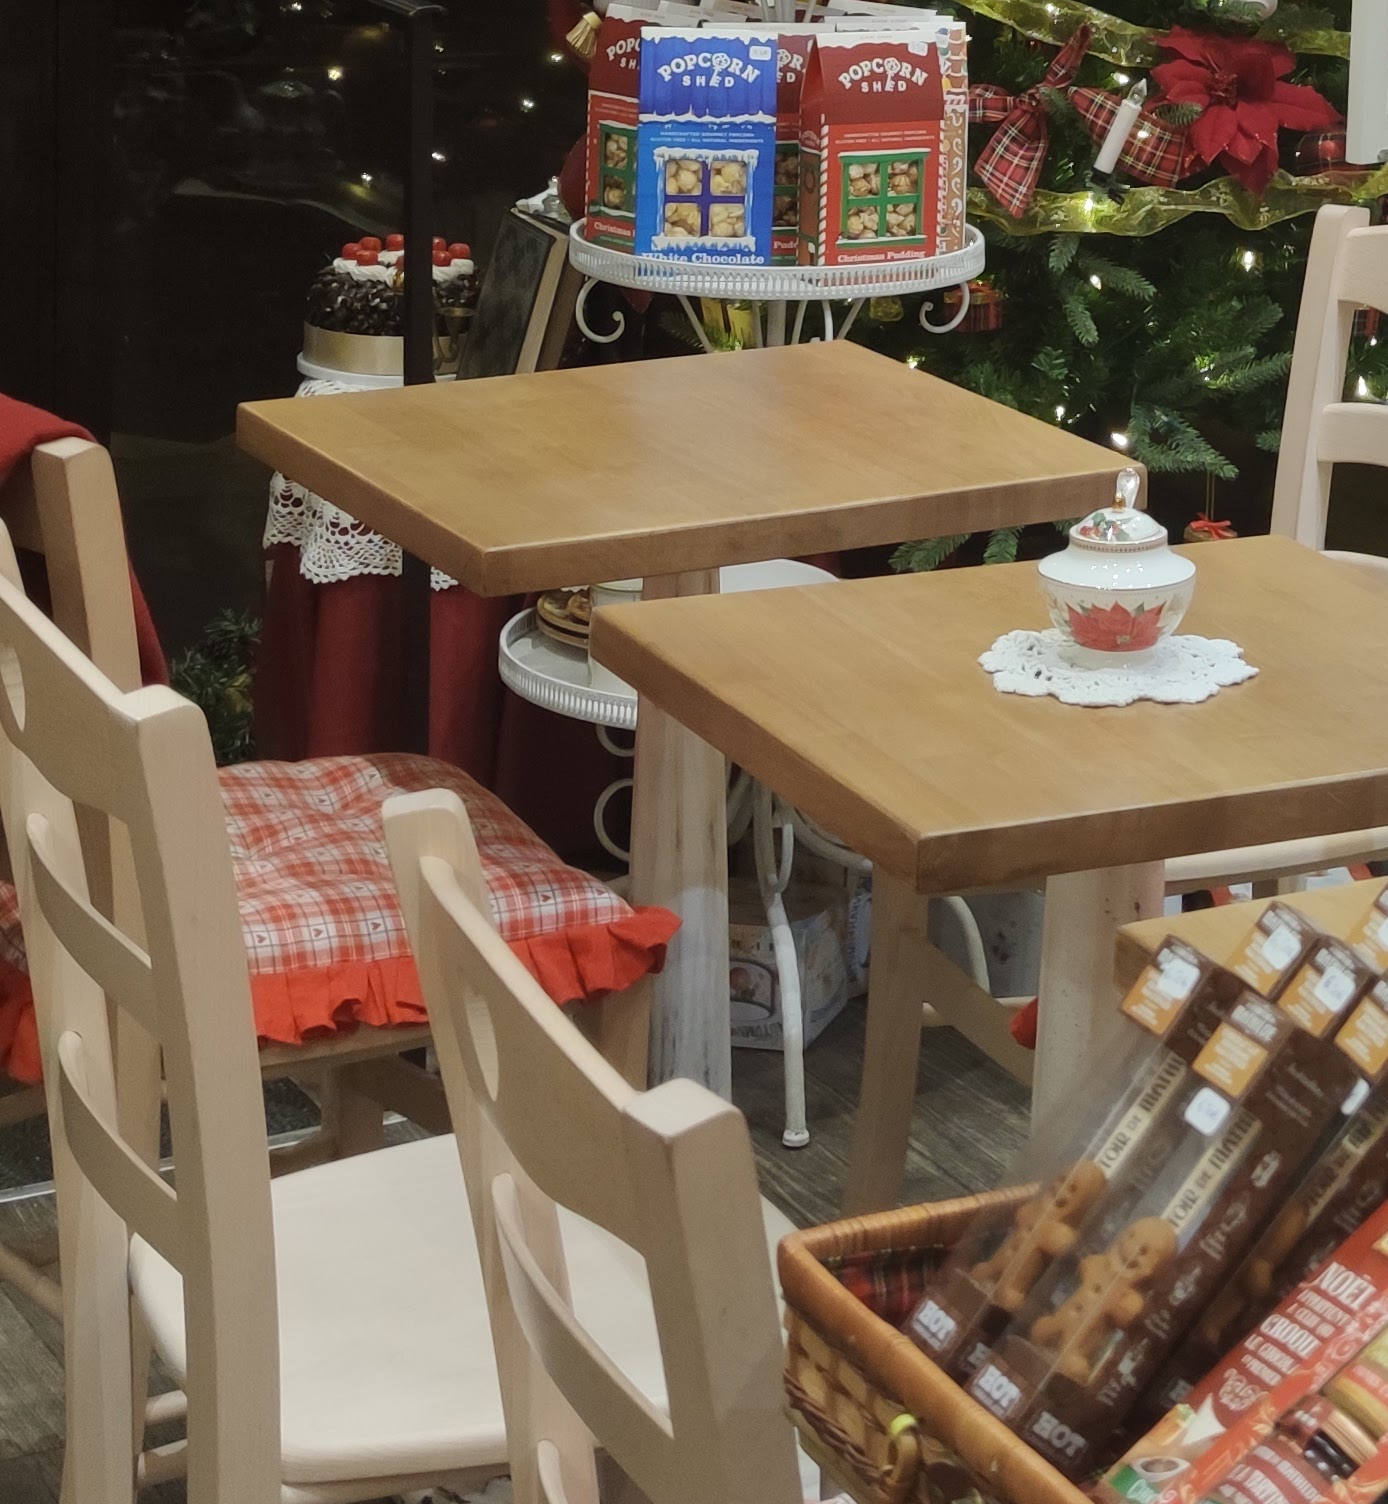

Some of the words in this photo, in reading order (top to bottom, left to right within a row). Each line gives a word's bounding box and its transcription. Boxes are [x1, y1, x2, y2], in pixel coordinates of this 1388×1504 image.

[657, 52, 761, 84] POPCORN
[682, 74, 735, 88] SHED
[838, 57, 929, 90] POPCORN
[861, 79, 907, 92] SHED
[642, 252, 687, 266] White
[691, 252, 765, 265] Chocolate
[837, 253, 885, 263] Christmas
[886, 250, 927, 261] Pudding
[918, 1299, 958, 1341] HOT
[977, 1363, 1021, 1409] HOT
[1032, 1410, 1087, 1458] HOT
